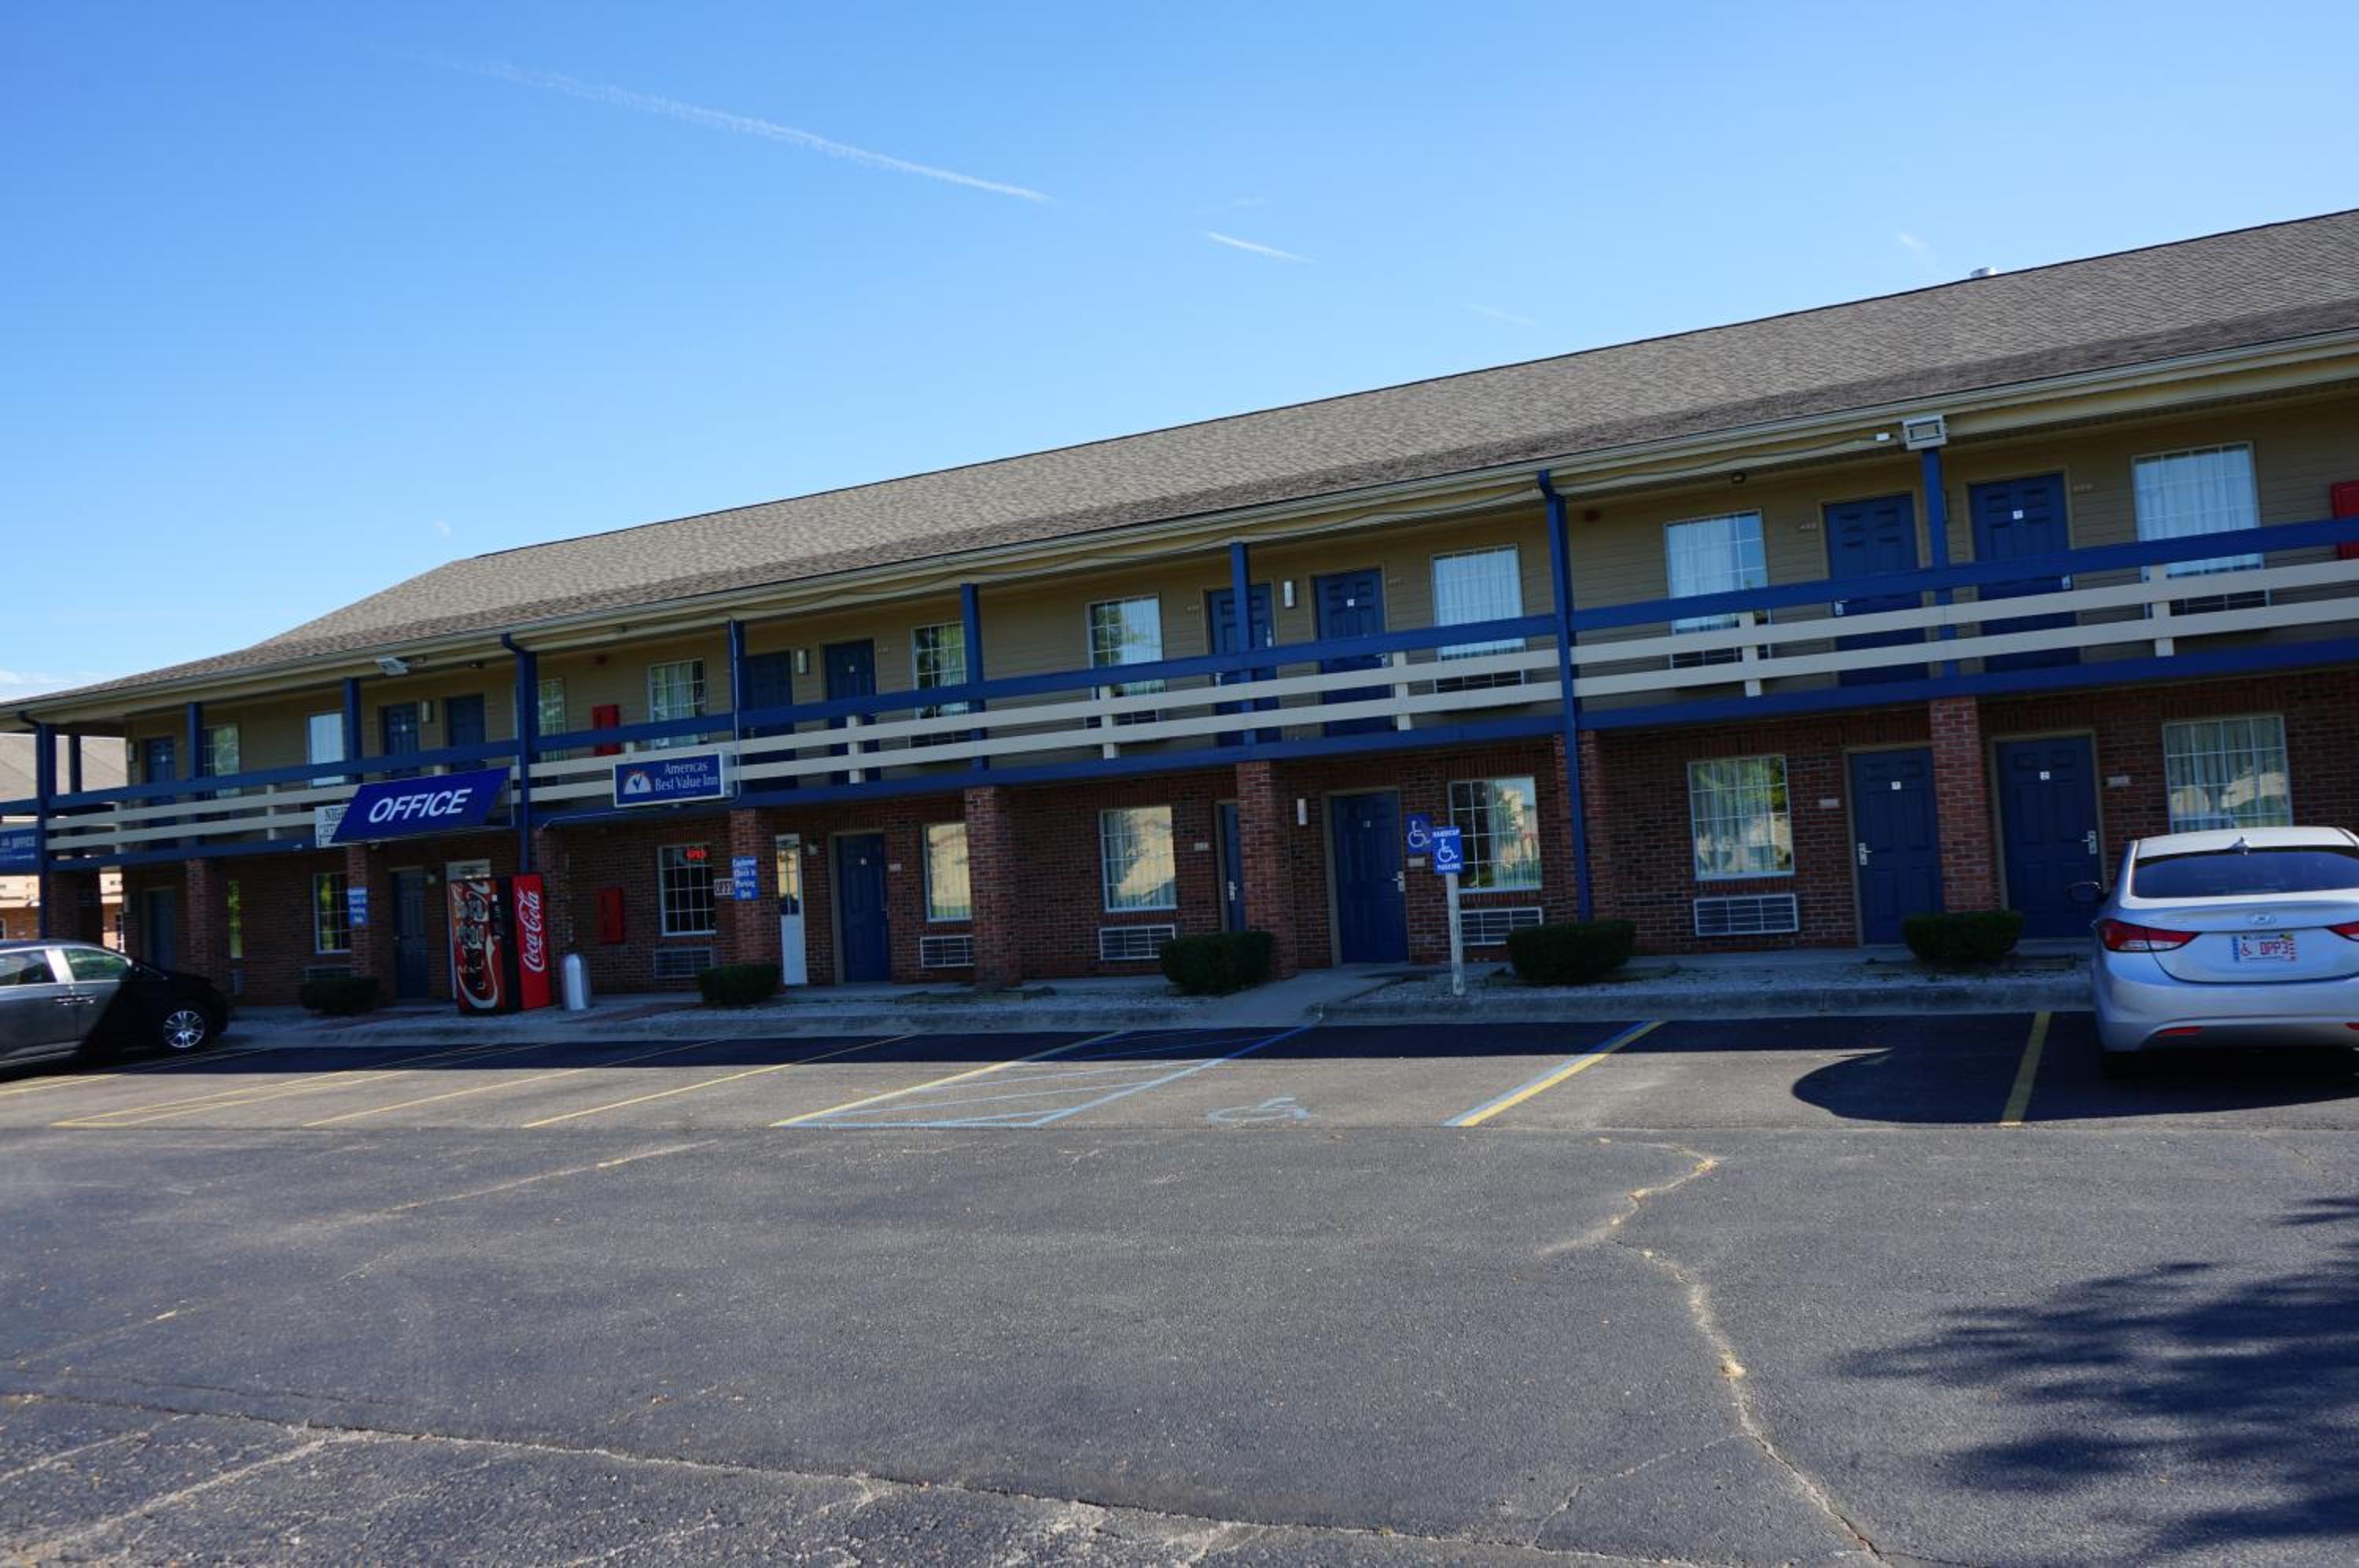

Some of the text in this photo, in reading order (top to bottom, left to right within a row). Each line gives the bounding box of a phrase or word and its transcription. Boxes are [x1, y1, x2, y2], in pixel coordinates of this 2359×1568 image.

[664, 761, 708, 775] Americas
[655, 773, 719, 791] Best Value Inn
[368, 787, 473, 823] OFFICE
[517, 889, 545, 973] Coca-Cola
